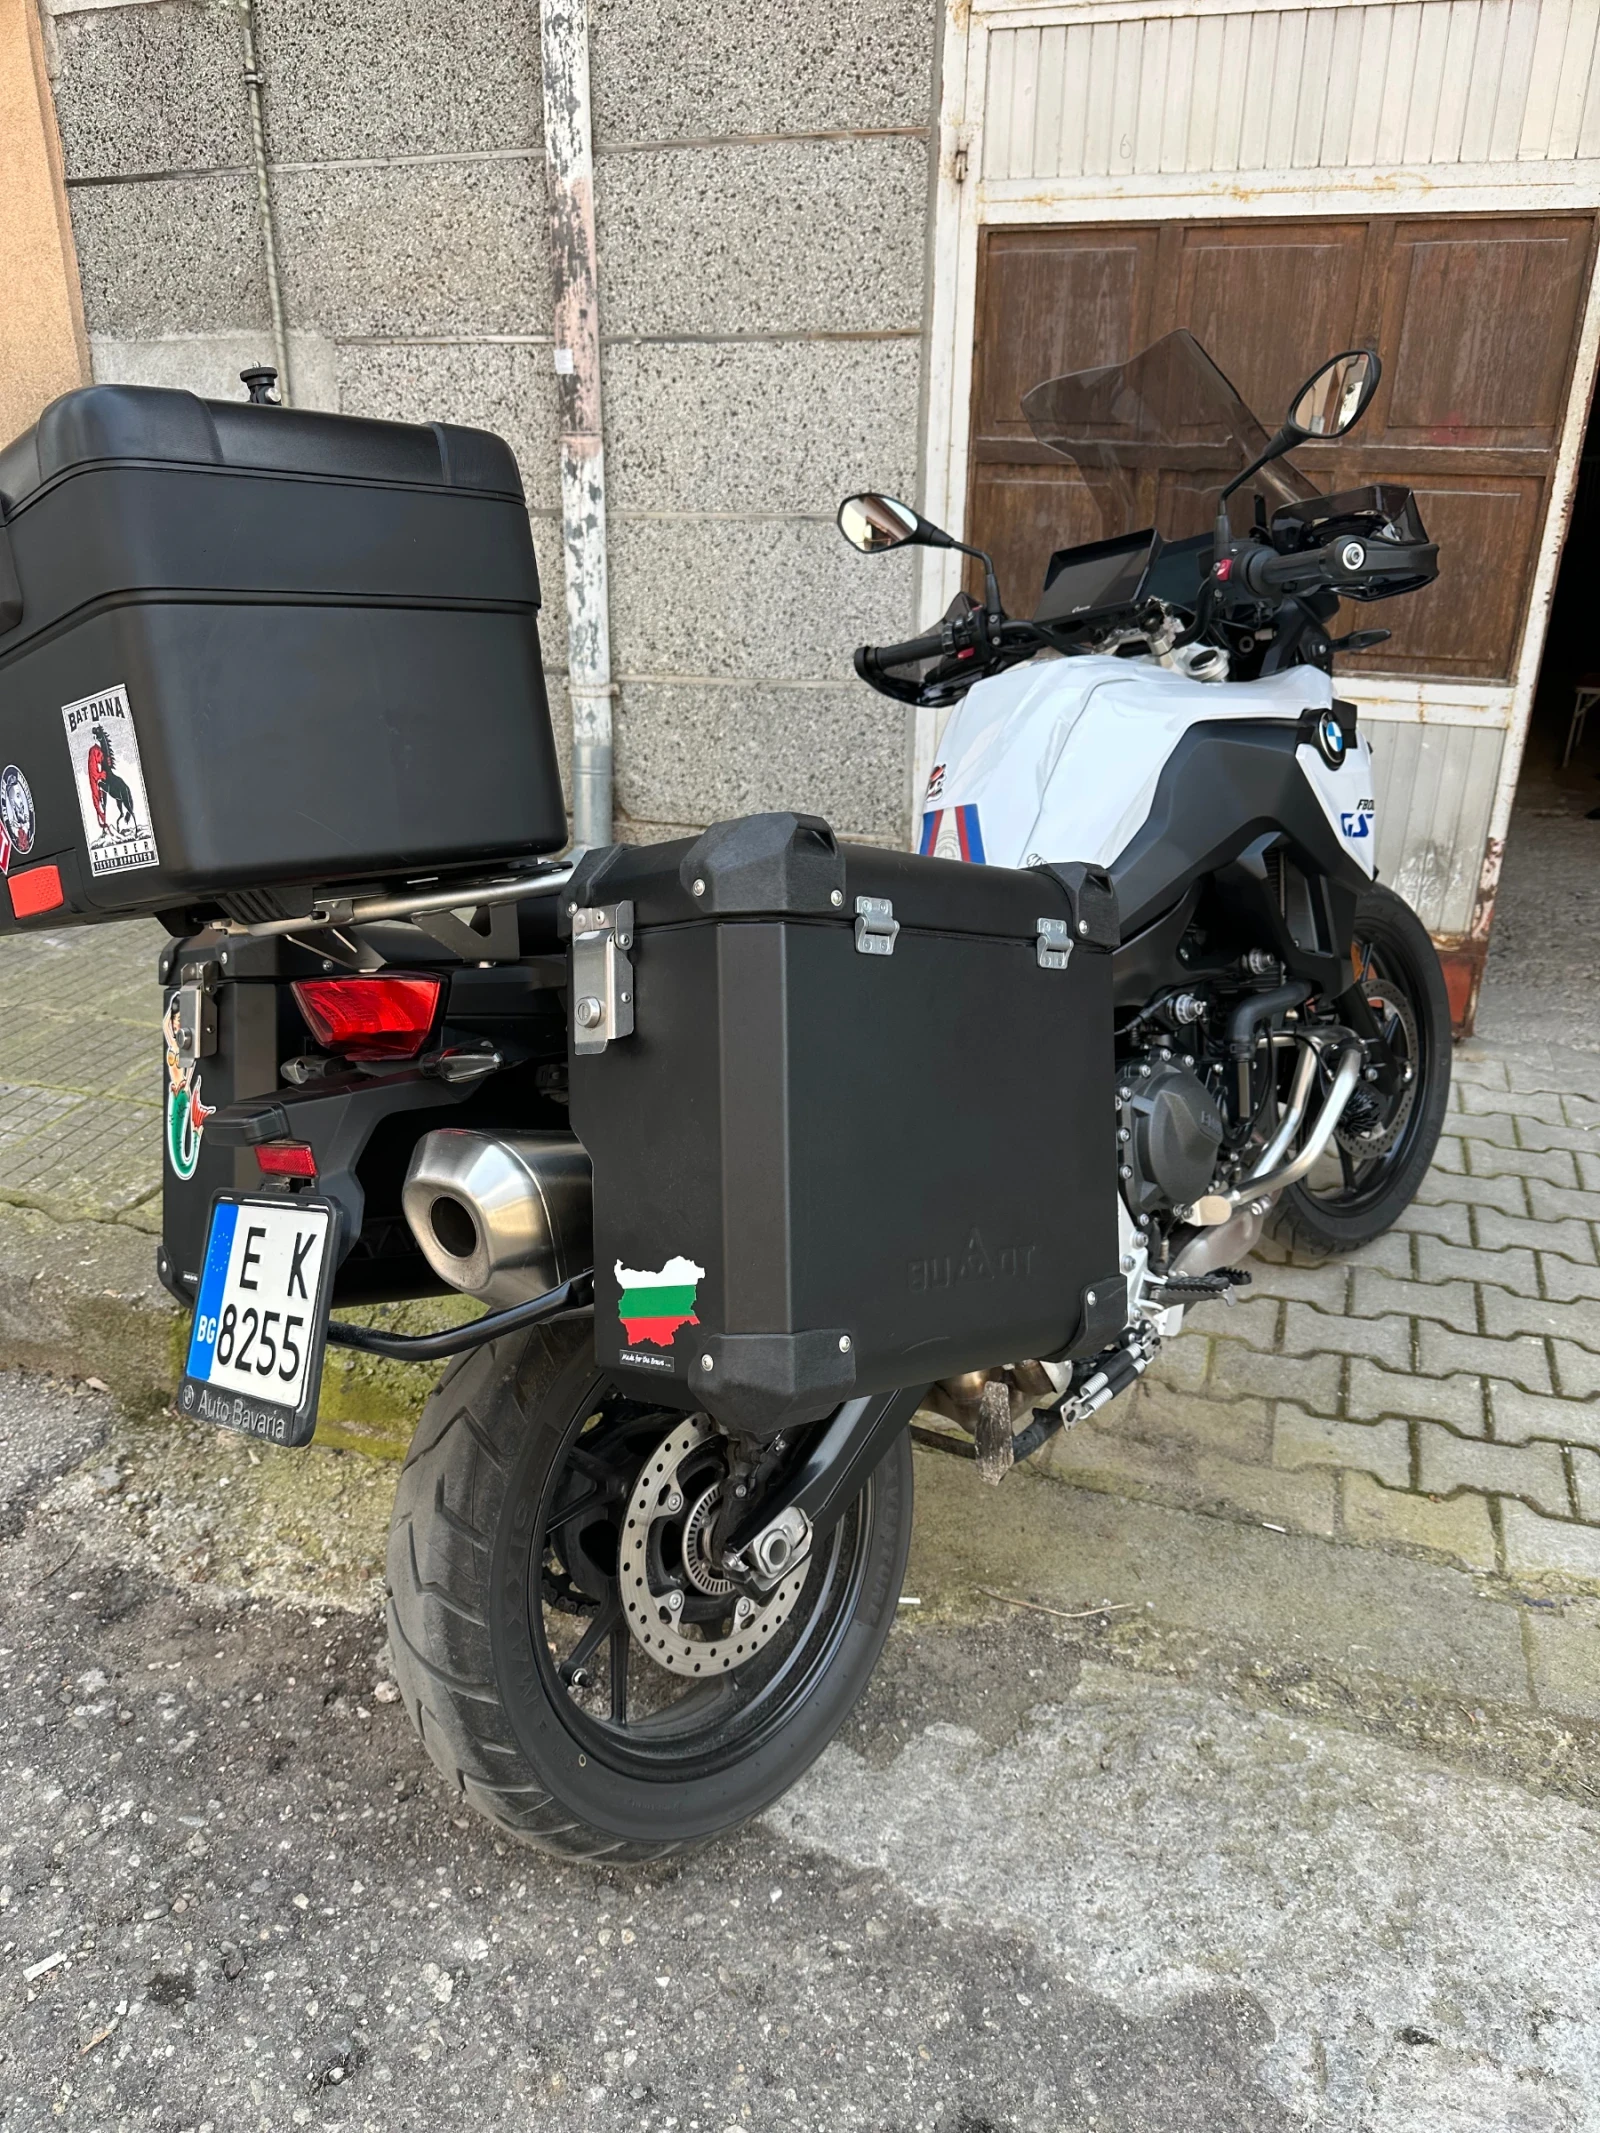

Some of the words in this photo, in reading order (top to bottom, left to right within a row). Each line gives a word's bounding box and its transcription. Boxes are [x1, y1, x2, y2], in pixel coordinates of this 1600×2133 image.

[90, 696, 125, 722] DANA
[1340, 813, 1374, 838] GS
[93, 841, 150, 861] BARBER
[239, 1226, 267, 1291] E
[287, 1231, 317, 1300] K
[196, 1315, 217, 1345] BG
[217, 1303, 304, 1383] 8255
[197, 1389, 230, 1422] Auto
[232, 1398, 286, 1438] Bavaria
